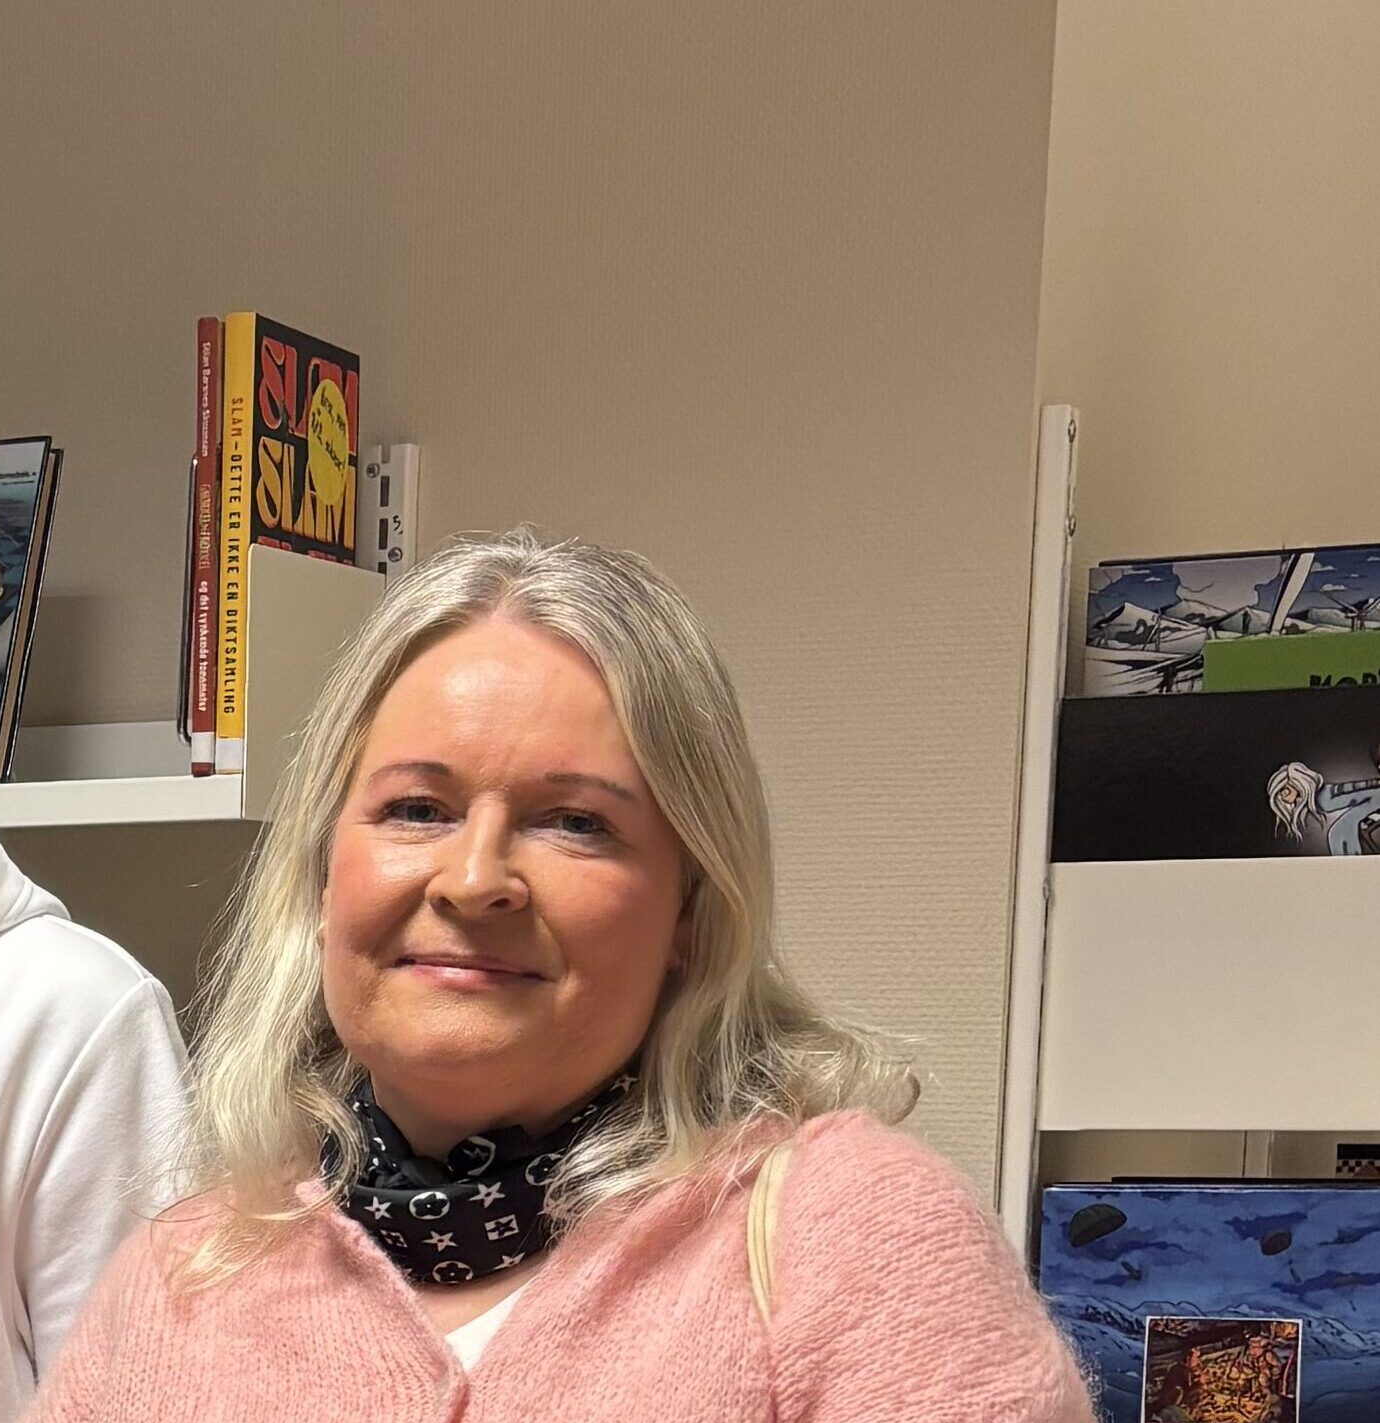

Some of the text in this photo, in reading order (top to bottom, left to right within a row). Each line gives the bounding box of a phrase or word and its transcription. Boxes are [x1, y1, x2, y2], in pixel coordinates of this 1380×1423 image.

[231, 397, 243, 438] SLAM
[228, 453, 243, 504] DETTE
[228, 510, 241, 530] ER
[226, 537, 240, 575] IKKE
[226, 581, 239, 601] EN
[223, 609, 238, 714] DIKTSAMLING
